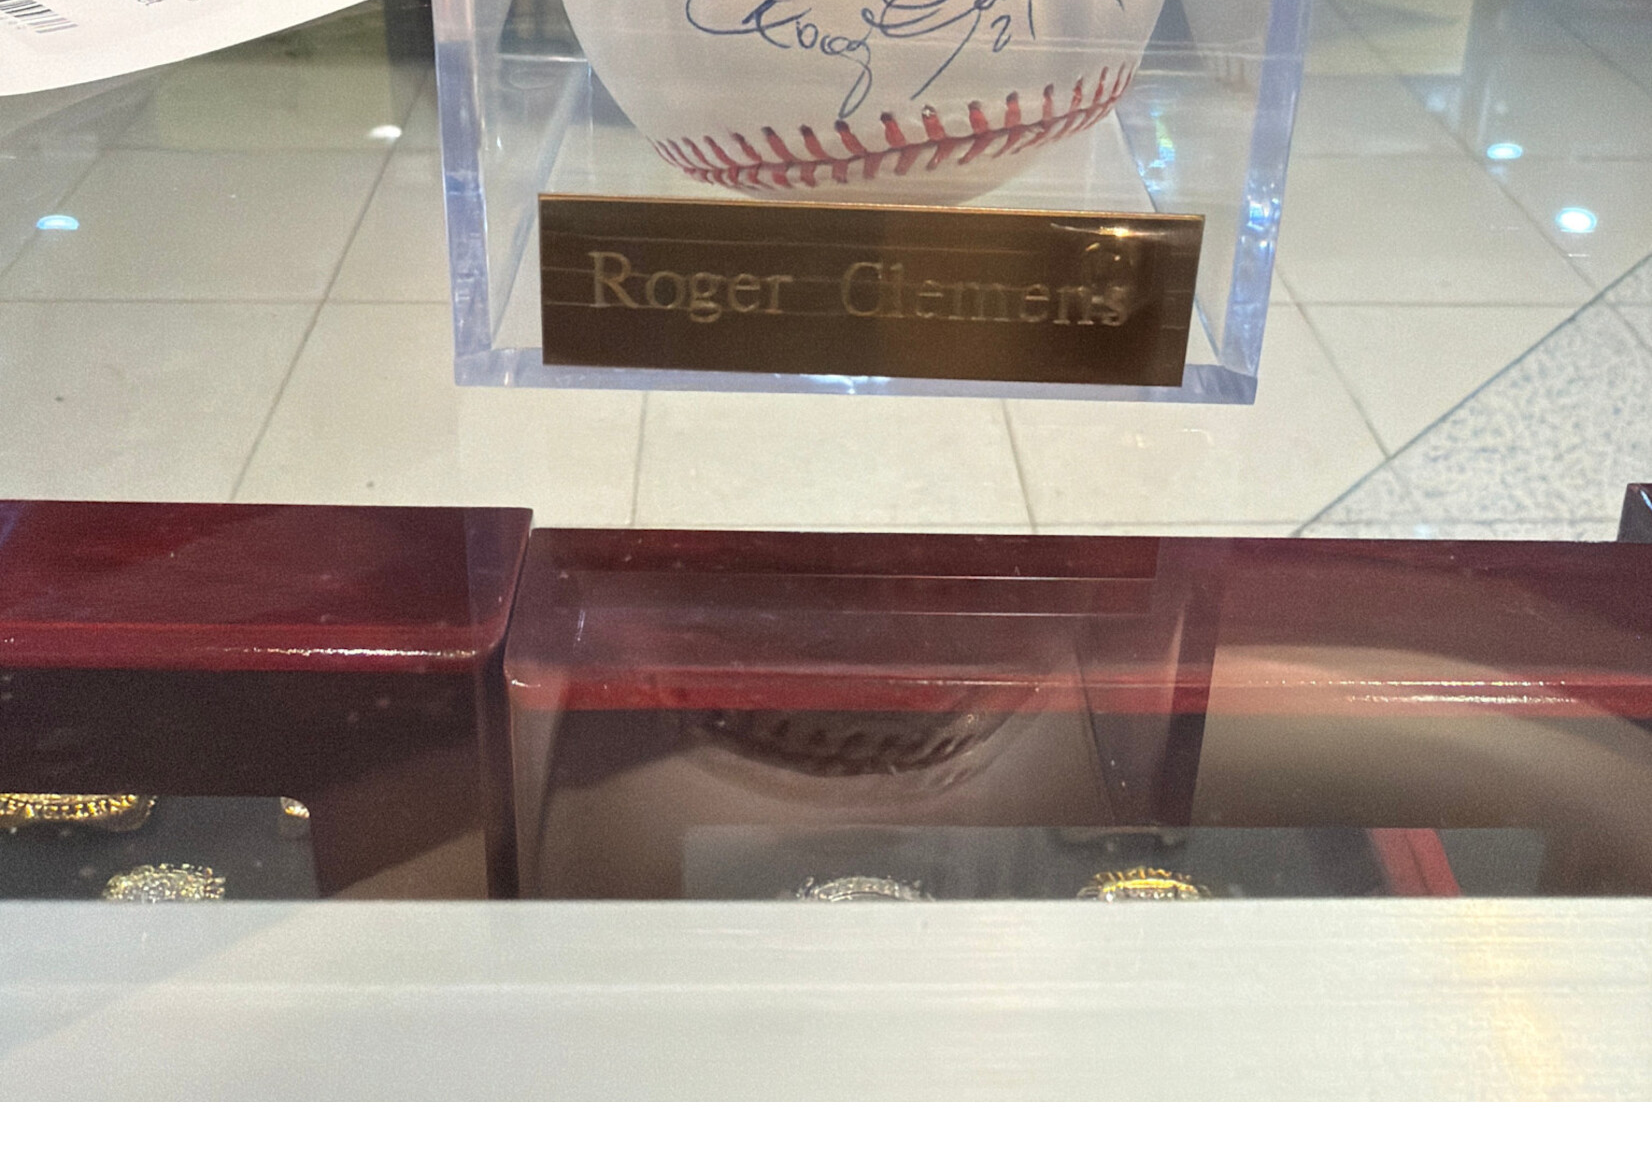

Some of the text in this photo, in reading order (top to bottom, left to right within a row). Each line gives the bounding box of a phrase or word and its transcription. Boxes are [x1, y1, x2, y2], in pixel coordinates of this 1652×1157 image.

[990, 0, 1037, 54] 21
[587, 250, 1129, 327] Roger Clemens
